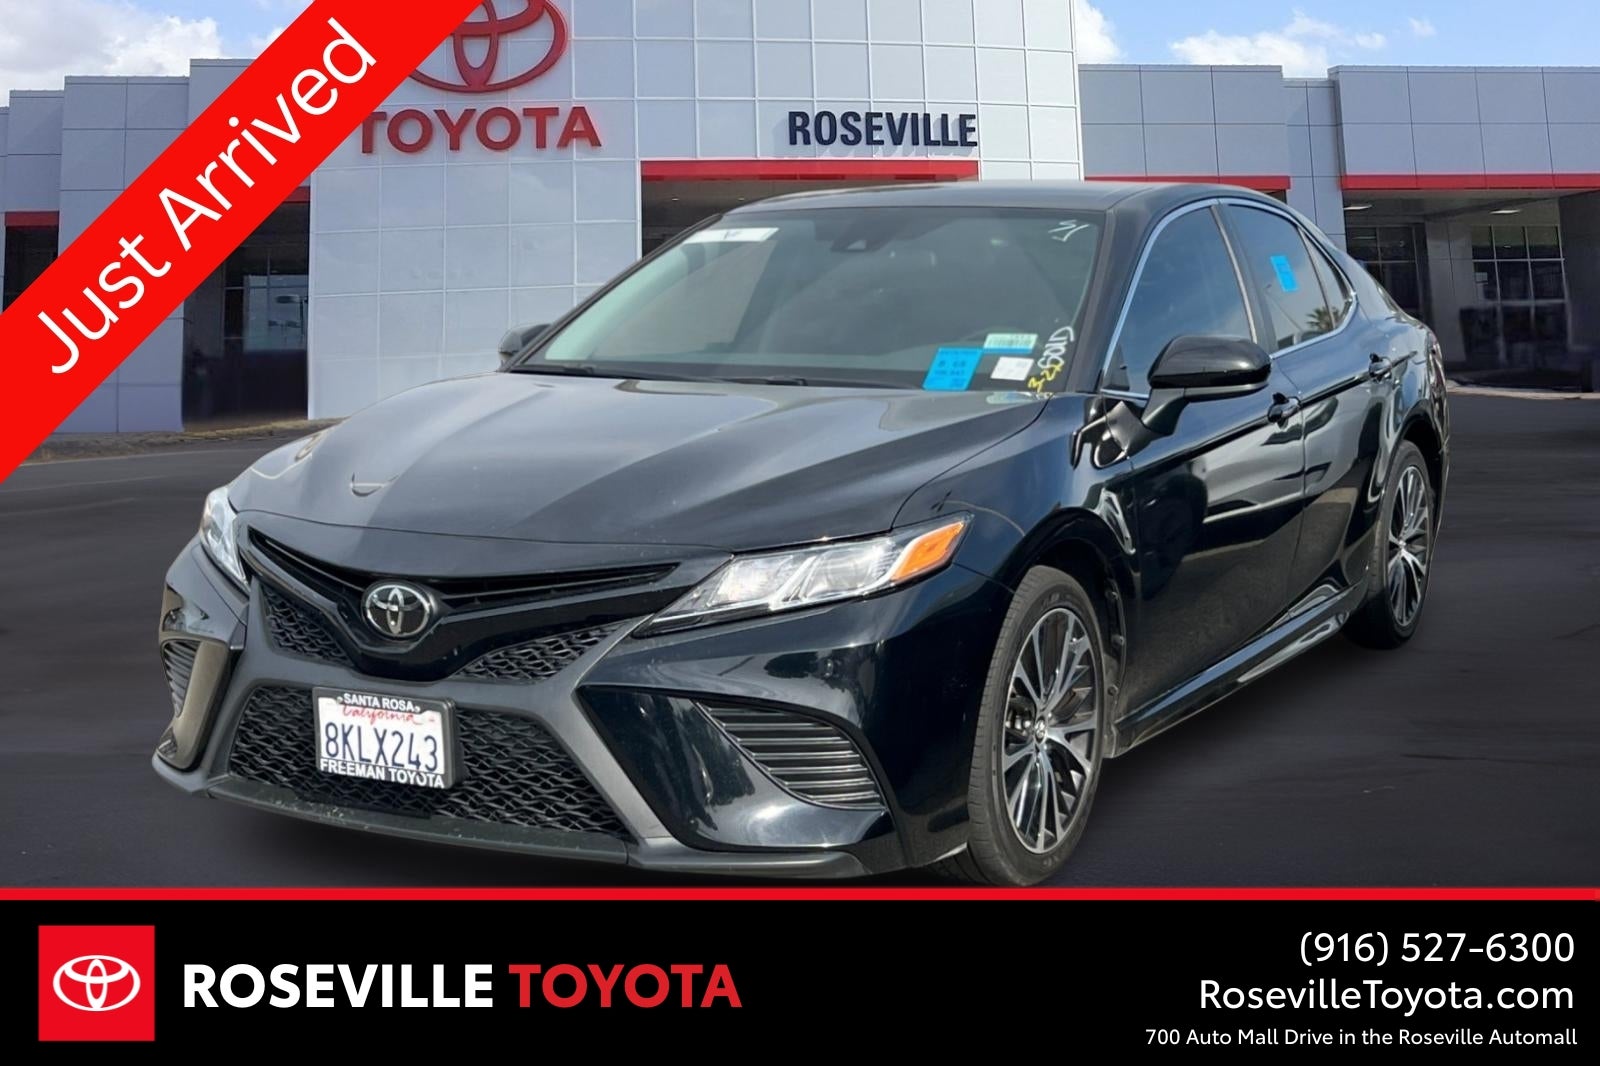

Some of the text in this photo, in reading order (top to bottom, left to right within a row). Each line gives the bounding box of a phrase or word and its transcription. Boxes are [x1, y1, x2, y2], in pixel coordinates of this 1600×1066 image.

[361, 106, 602, 154] TOYOTA
[788, 110, 978, 147] ROSEVILLE
[343, 693, 414, 712] SANTA ROSA
[324, 722, 439, 773] 8KLX243
[320, 758, 445, 788] FREEMAN TOYOTA
